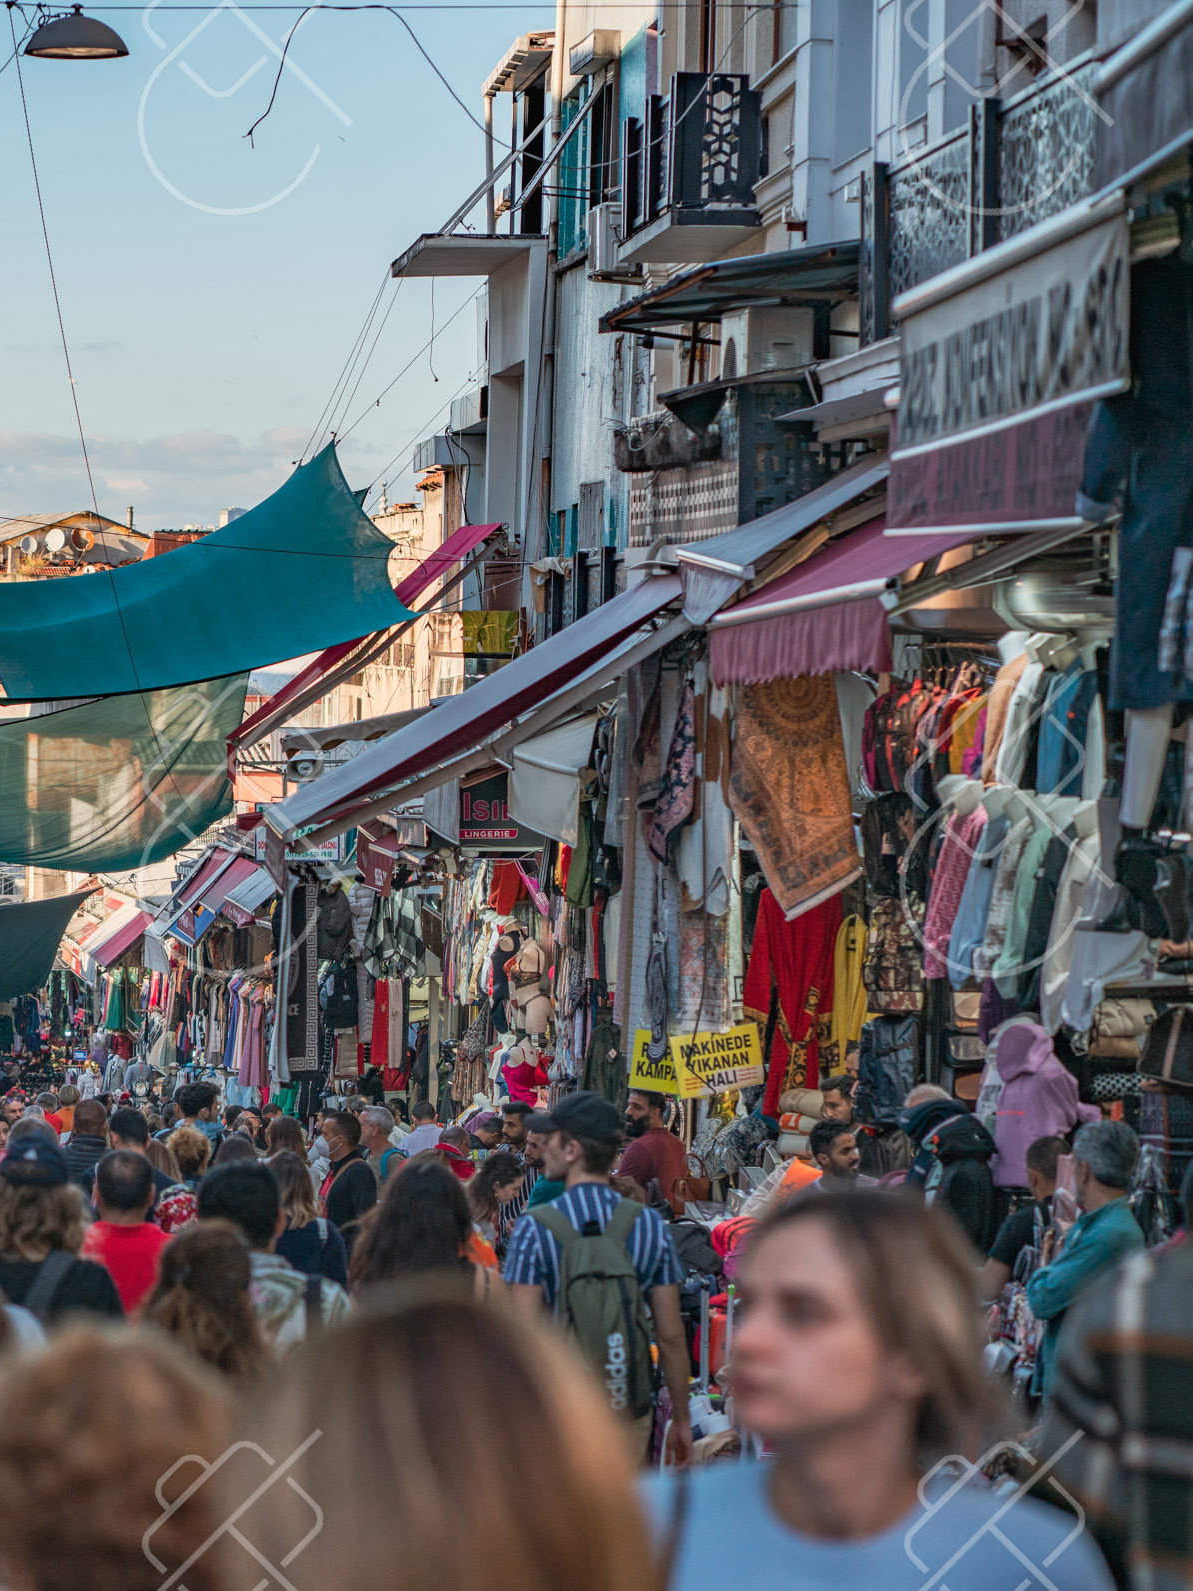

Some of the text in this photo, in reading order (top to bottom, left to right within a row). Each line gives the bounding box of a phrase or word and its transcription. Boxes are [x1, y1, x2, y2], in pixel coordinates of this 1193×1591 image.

[464, 830, 510, 838] LINGERIE
[680, 1034, 752, 1059] MAKİNEDE
[688, 1051, 750, 1073] YIKANAN
[706, 1070, 738, 1087] HALI
[605, 1331, 626, 1409] adidas
